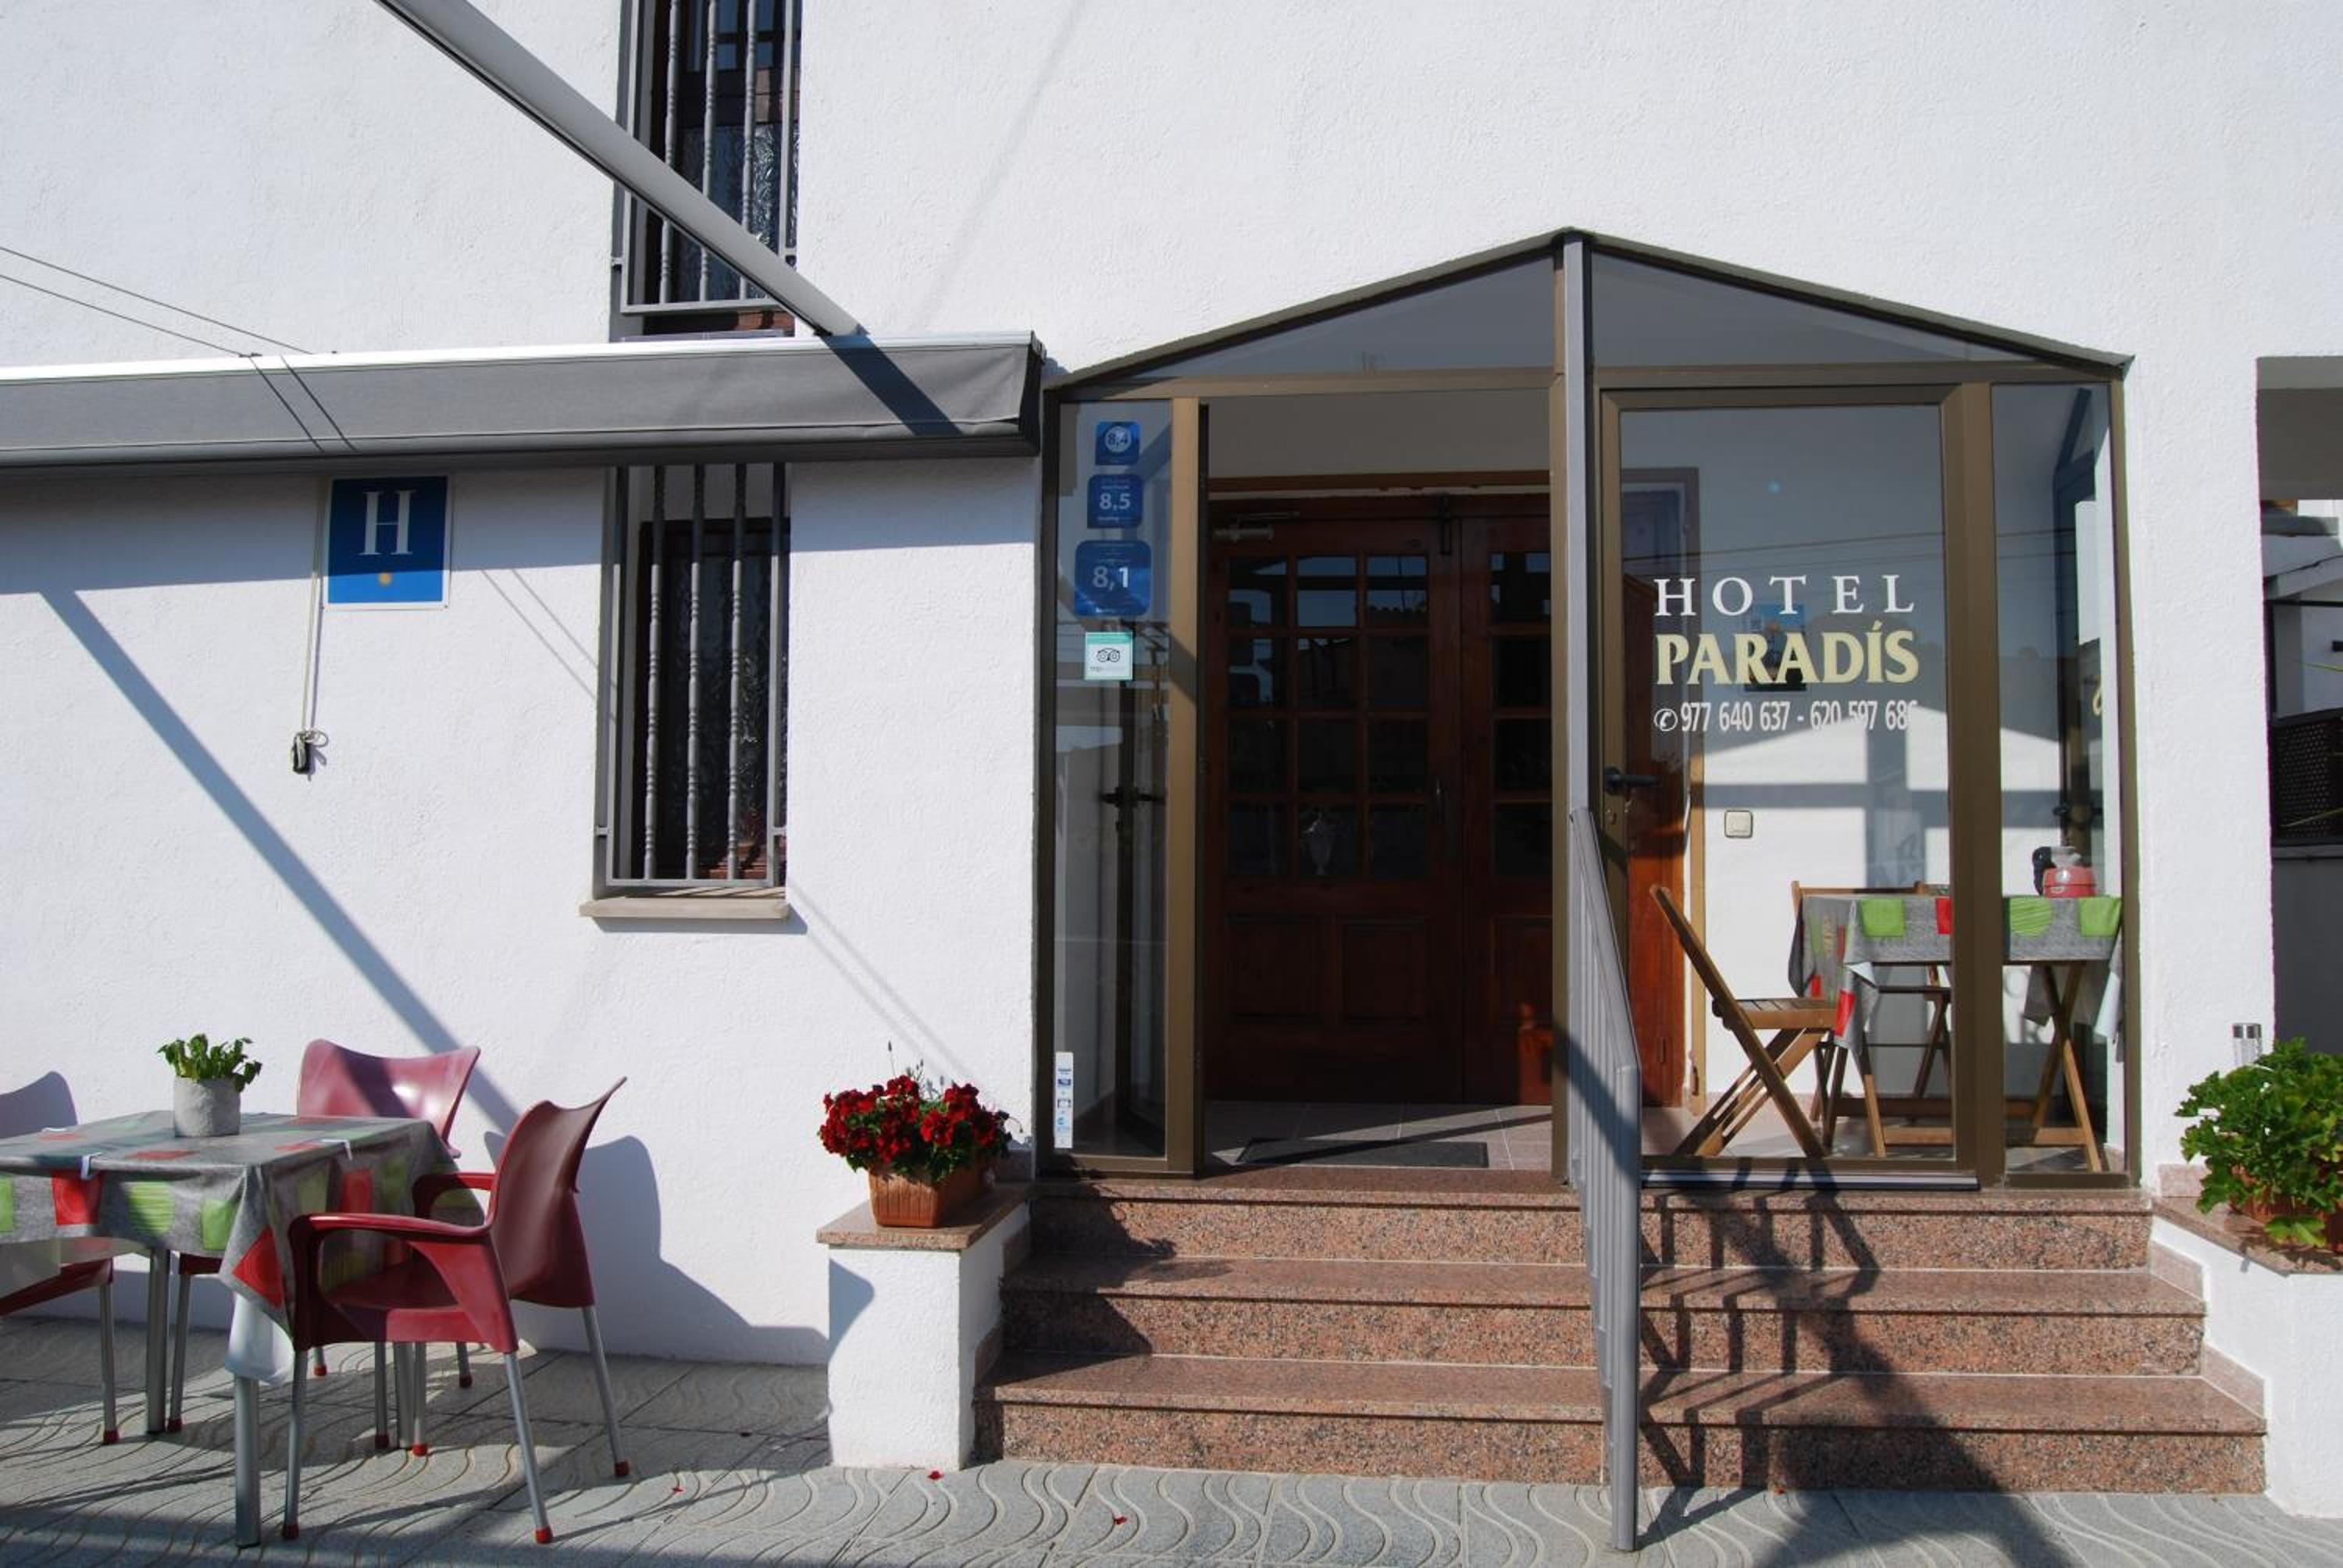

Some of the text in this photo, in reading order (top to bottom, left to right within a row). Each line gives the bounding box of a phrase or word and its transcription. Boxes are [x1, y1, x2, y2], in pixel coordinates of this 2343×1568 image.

[1099, 492, 1131, 511] 8,5
[355, 490, 417, 555] H
[1092, 565, 1129, 591] 8,1
[1653, 574, 1914, 616] HOTEL
[1655, 620, 1919, 685] PARADÍS
[1681, 702, 1710, 732] 977
[1719, 701, 1753, 732] 640
[1760, 701, 1789, 731] 637
[1810, 700, 1842, 730] 620
